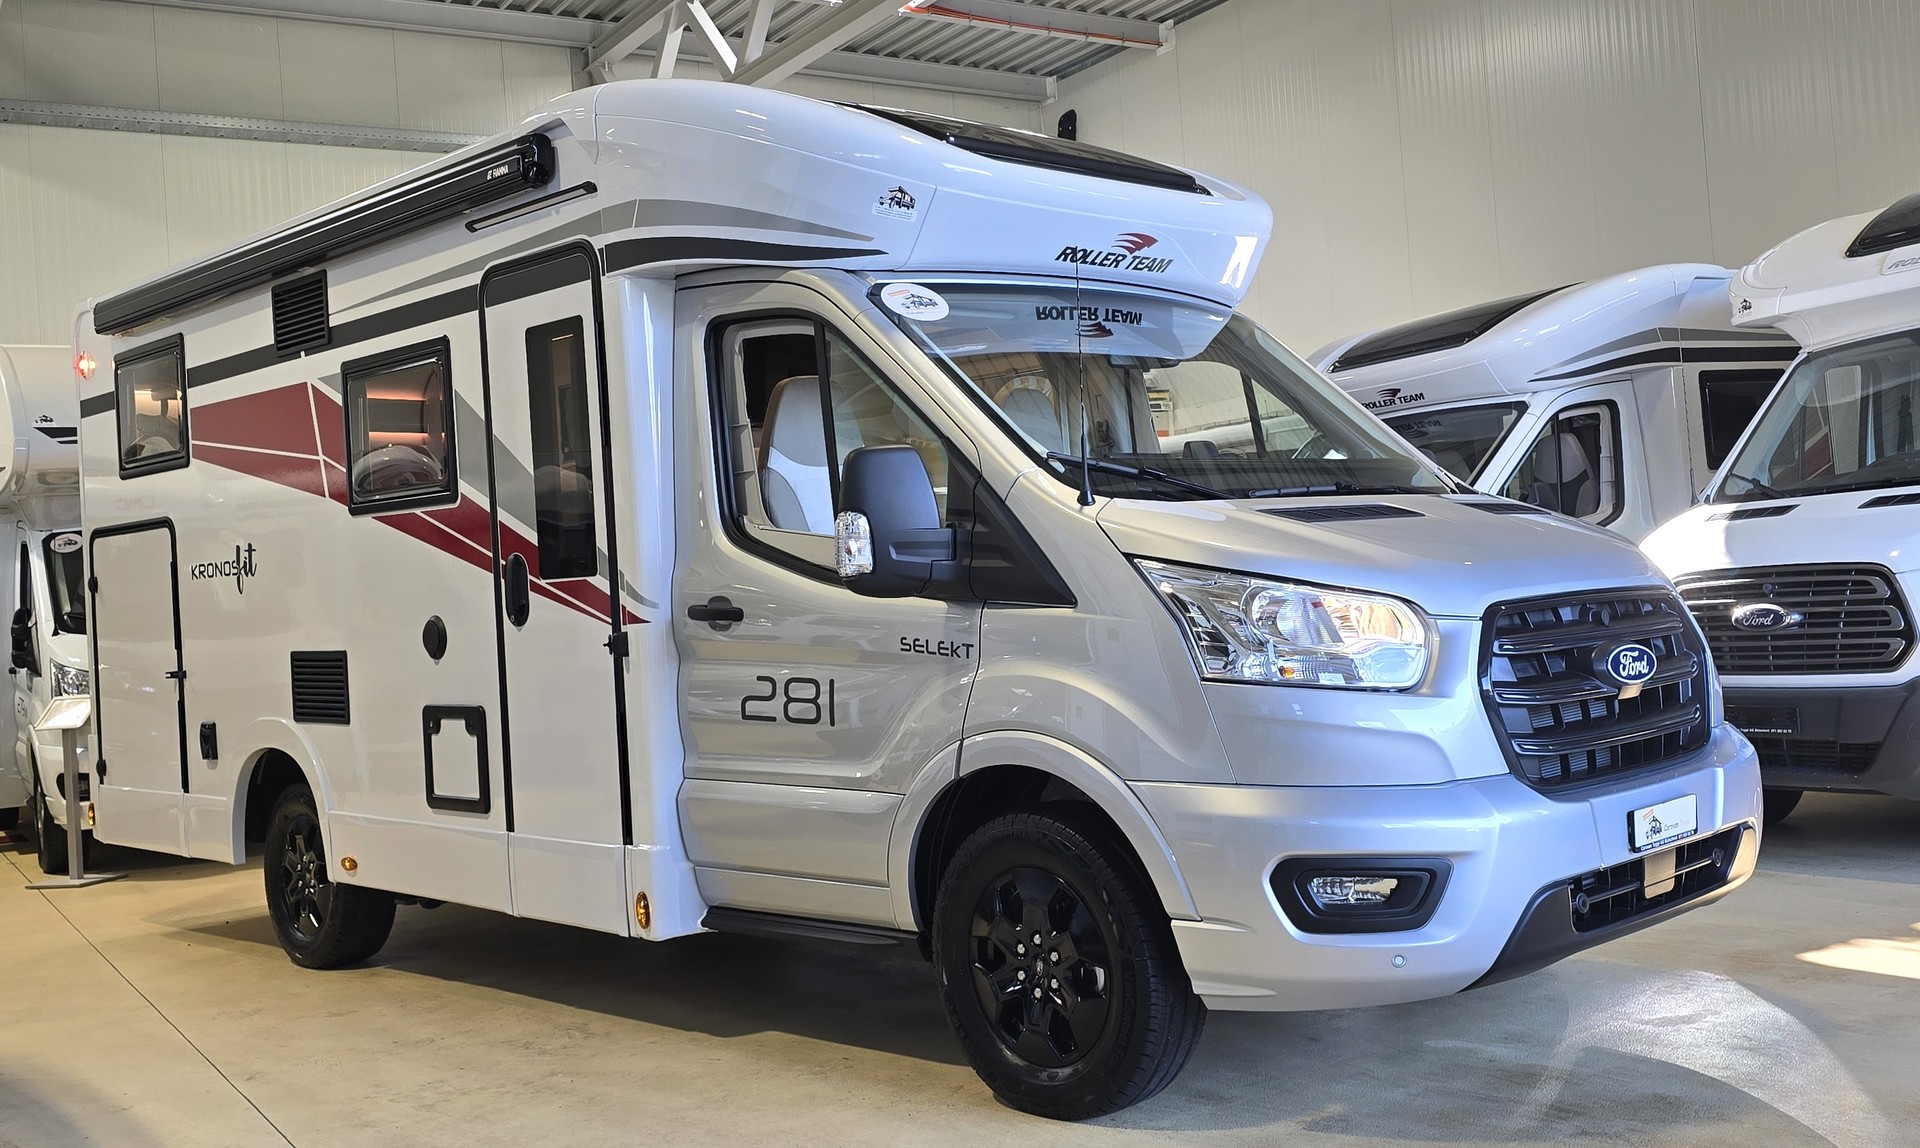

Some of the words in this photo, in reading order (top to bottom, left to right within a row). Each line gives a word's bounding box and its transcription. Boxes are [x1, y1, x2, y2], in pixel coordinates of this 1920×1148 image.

[1055, 246, 1127, 269] ROLLER
[1125, 255, 1174, 273] TEAM
[1396, 393, 1426, 405] TEAM
[1619, 650, 1650, 677] Ford
[741, 675, 836, 727] 281
